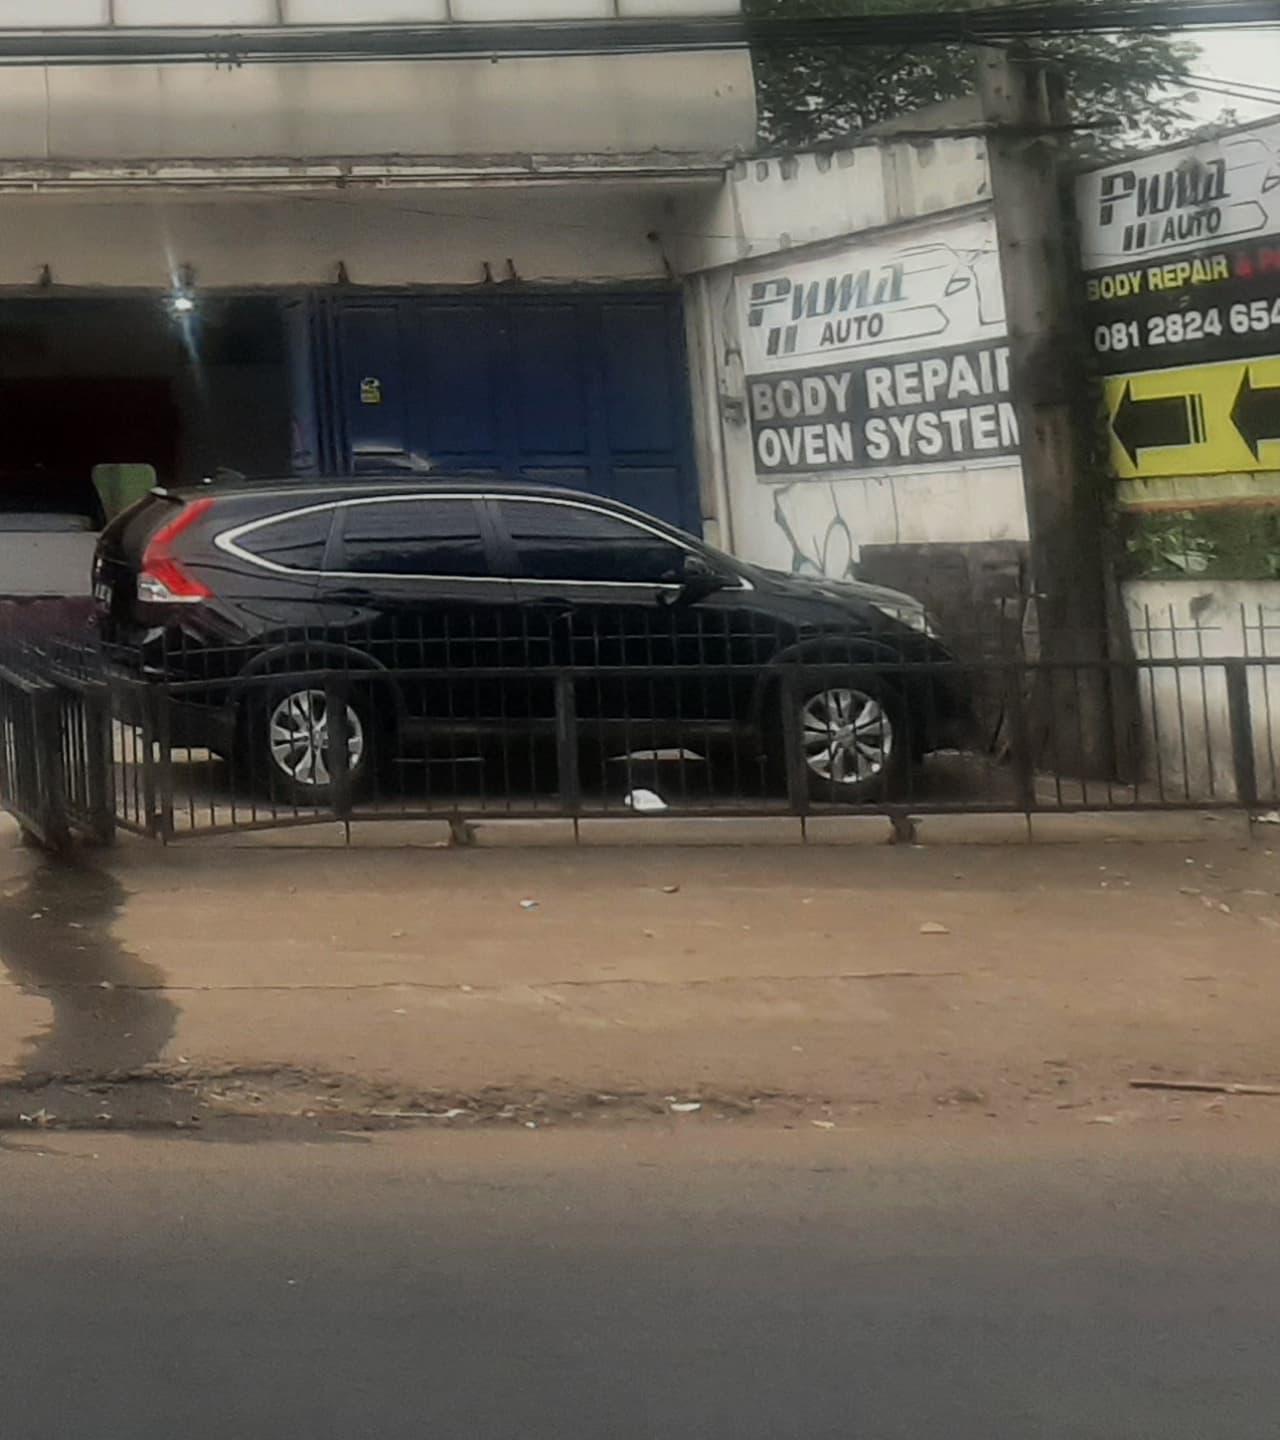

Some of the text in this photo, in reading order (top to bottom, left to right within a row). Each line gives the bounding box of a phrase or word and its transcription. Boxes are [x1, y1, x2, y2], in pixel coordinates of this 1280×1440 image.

[1161, 207, 1221, 243] AUTO
[1088, 270, 1141, 300] BODY
[1147, 254, 1229, 291] REPAIR
[820, 313, 883, 346] AUTO
[1095, 321, 1140, 352] 081
[1147, 308, 1222, 345] 2824
[752, 372, 852, 421] BODY
[758, 422, 853, 467] OVEN
